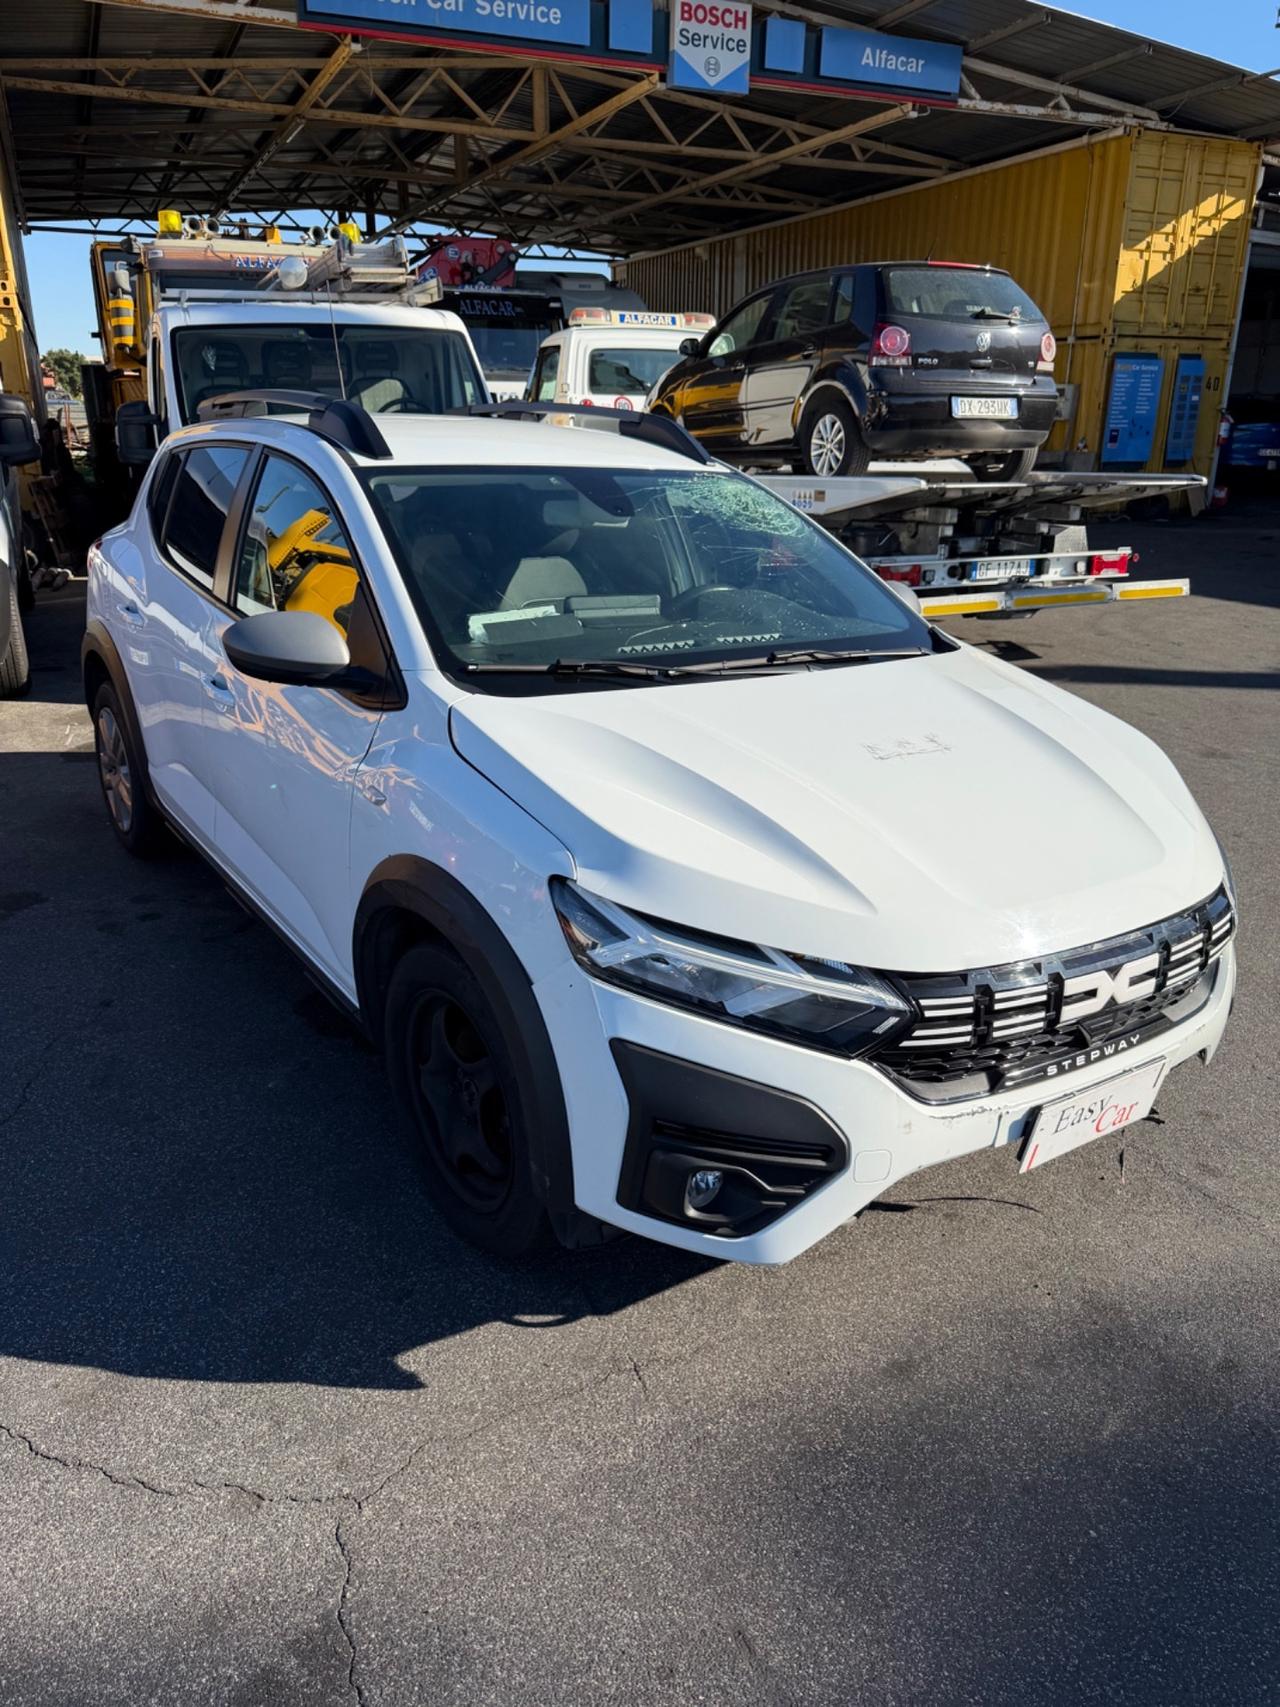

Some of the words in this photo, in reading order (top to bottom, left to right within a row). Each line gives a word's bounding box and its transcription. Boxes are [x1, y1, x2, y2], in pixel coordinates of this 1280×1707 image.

[475, 0, 562, 25] Service
[679, 1, 747, 30] BOSCH
[679, 28, 747, 54] Service
[861, 47, 925, 74] Alfacar
[235, 255, 311, 268] ALFA
[459, 299, 516, 317] ALFACAR
[624, 314, 672, 326] ALFACAR
[918, 357, 938, 366] POLO
[1206, 375, 1221, 392] 40
[960, 400, 974, 413] DX
[978, 400, 1010, 414] 293WK
[978, 562, 992, 577] GF
[996, 559, 1030, 577] 117AJ
[1046, 1034, 1140, 1077] STEPWAY
[1053, 1095, 1113, 1134] Easy
[1094, 1101, 1138, 1134] Car
